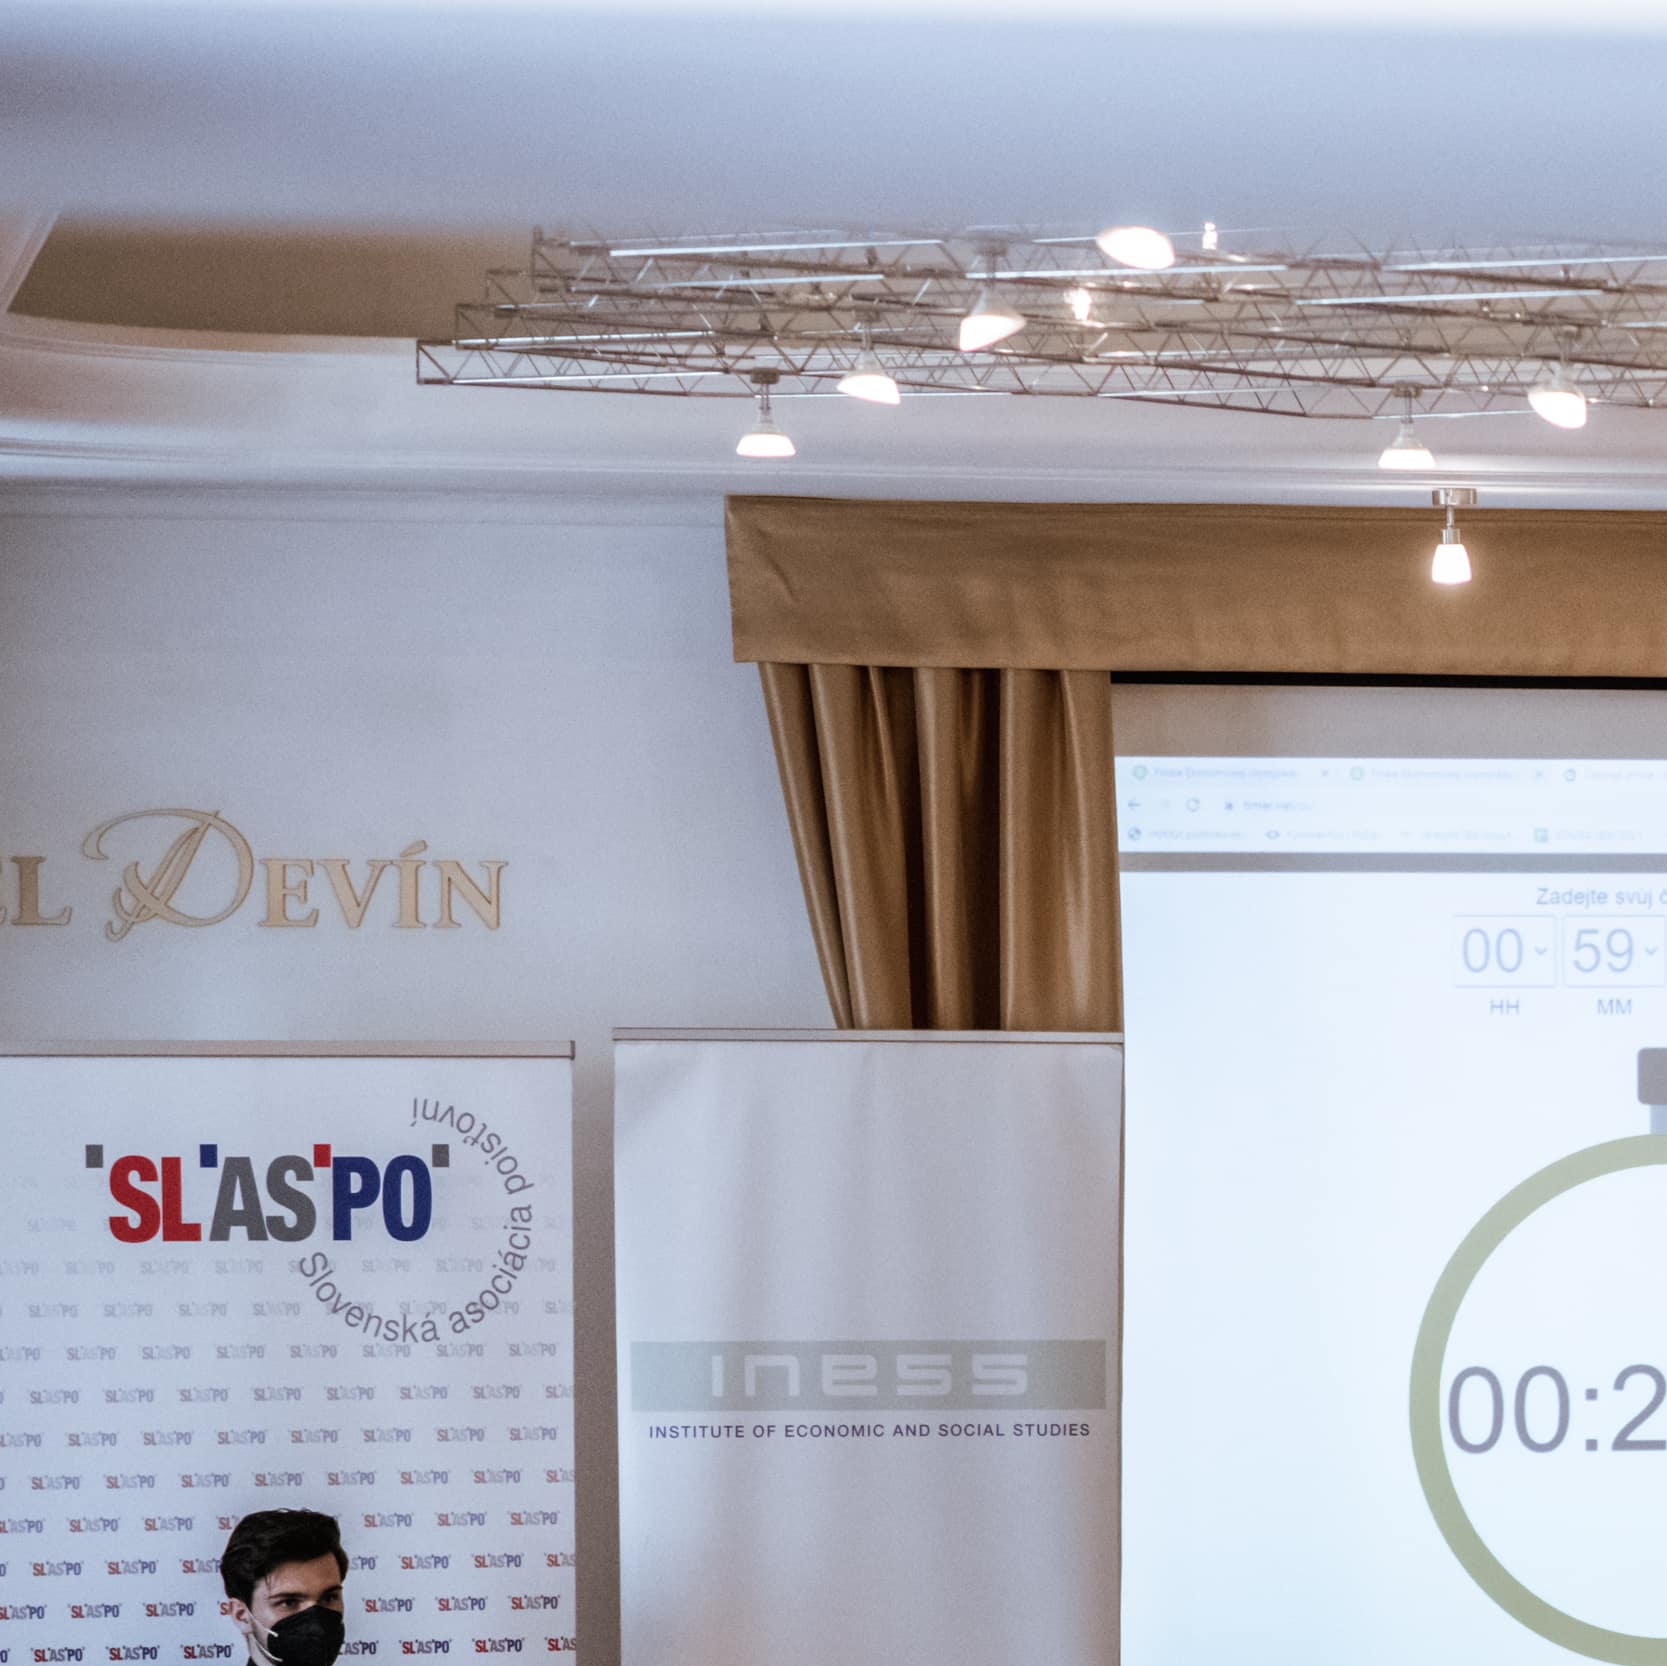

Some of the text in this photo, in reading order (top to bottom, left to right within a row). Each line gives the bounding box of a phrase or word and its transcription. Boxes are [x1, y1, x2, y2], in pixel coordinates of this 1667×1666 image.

[1536, 887, 1608, 909] Zadejte
[1462, 927, 1524, 974] 00
[1572, 927, 1635, 974] 59
[1489, 999, 1520, 1015] HH
[1597, 999, 1632, 1015] MM
[449, 1203, 533, 1334] asociácia
[299, 1252, 441, 1343] Slovenská
[649, 1423, 1090, 1439] INSTITUTE OF ECONOMIC AND SOCIAL STUDIES
